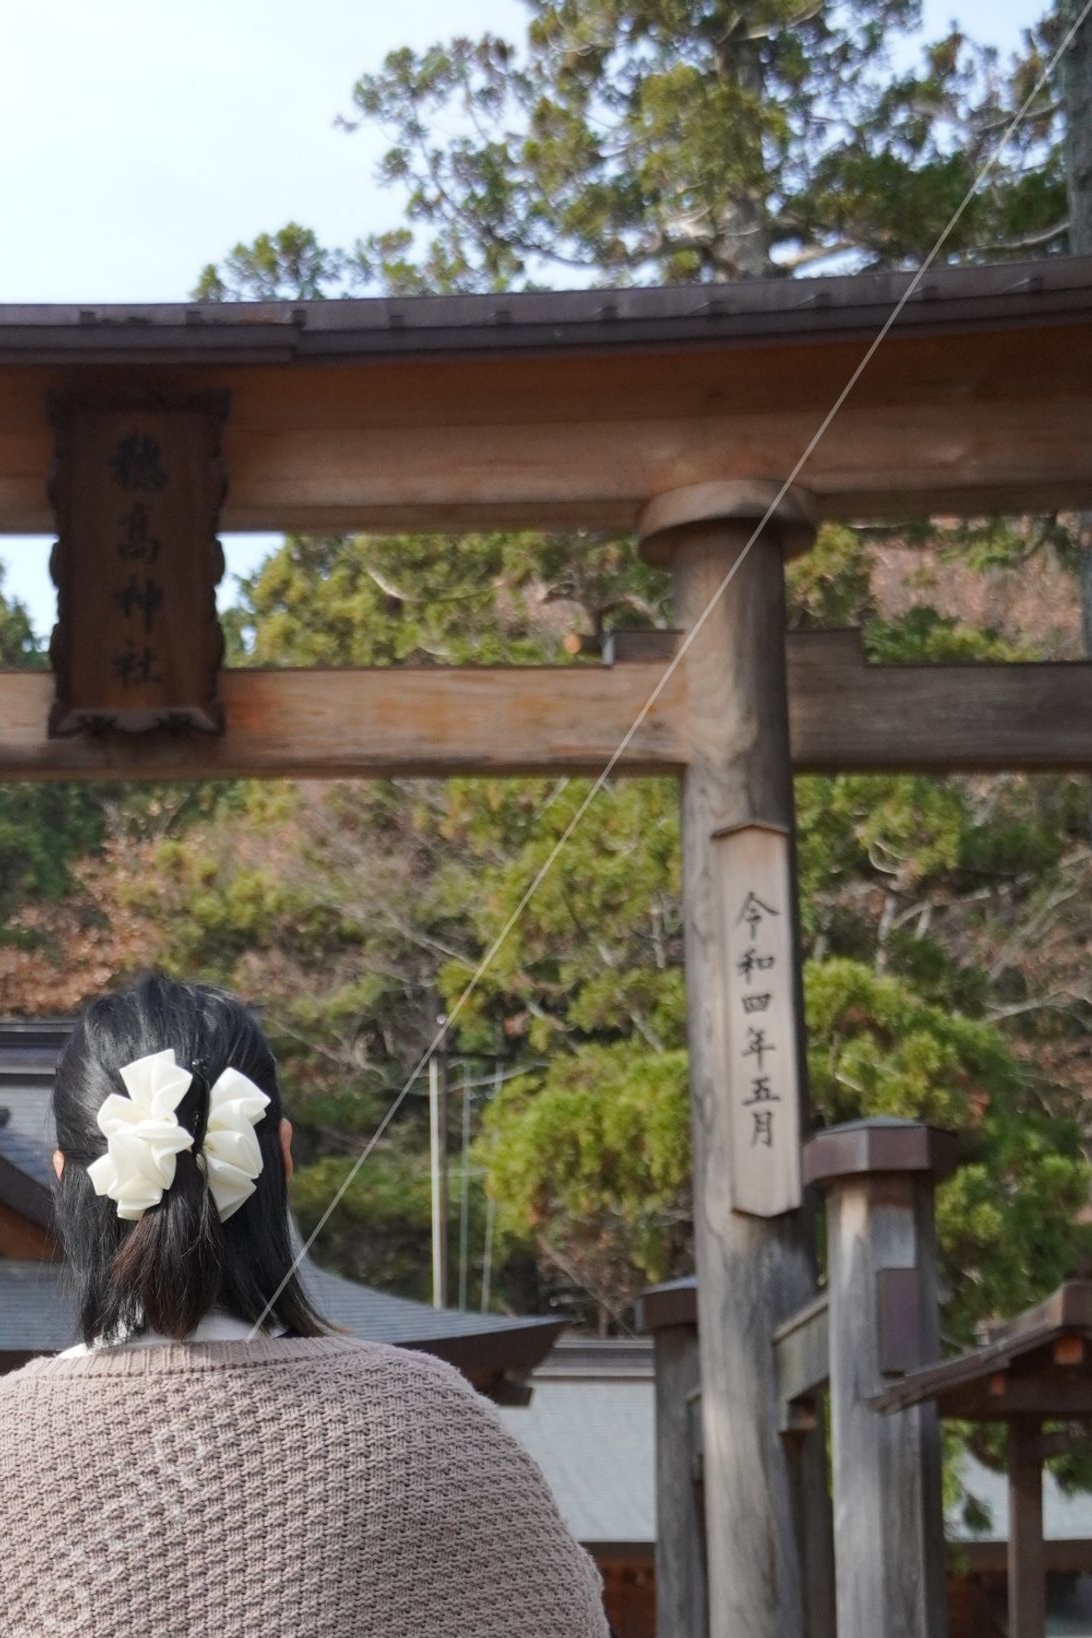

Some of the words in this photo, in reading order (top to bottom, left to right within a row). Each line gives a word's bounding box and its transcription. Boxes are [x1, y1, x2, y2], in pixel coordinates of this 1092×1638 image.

[736, 891, 781, 1148] 令和四年五月
